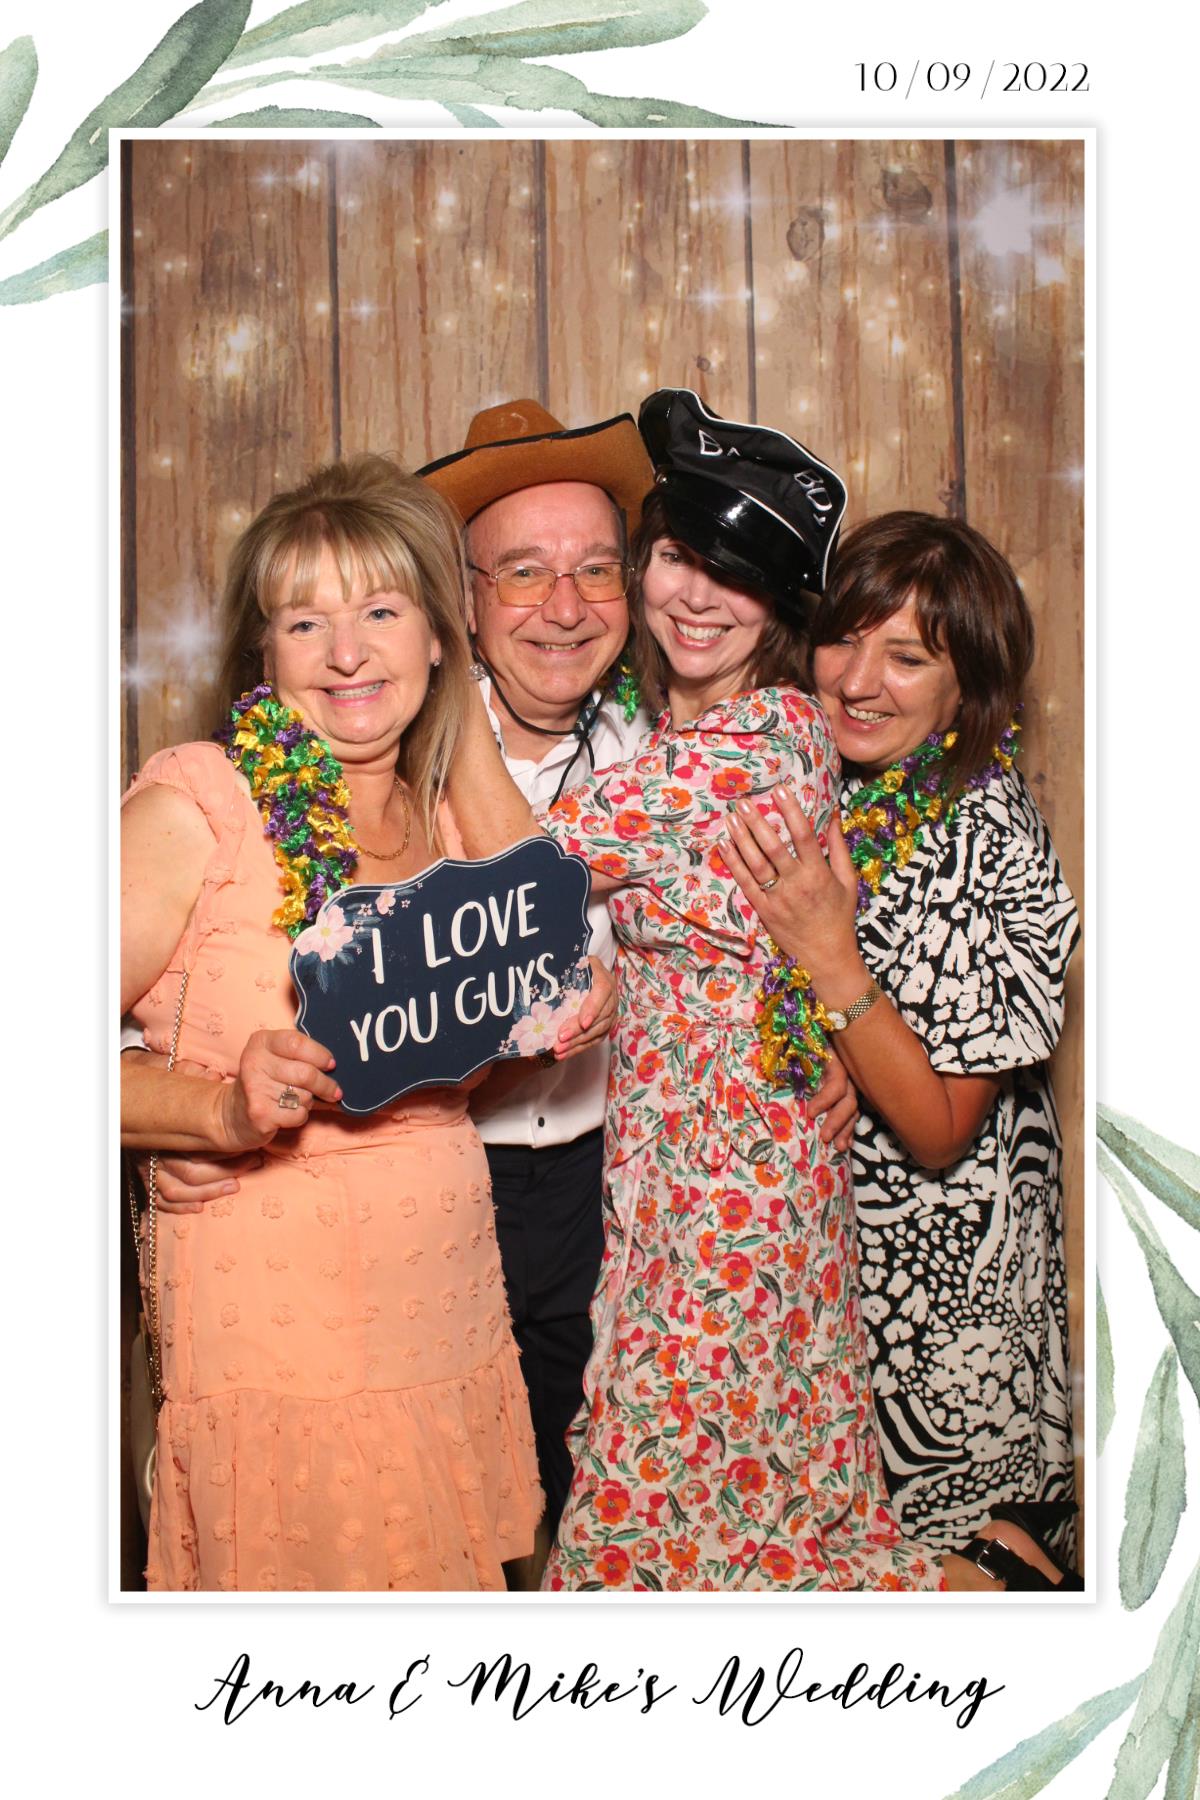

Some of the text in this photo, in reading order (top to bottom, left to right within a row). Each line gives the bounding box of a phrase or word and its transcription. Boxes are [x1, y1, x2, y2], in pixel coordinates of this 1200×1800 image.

[371, 881, 540, 985] I LOVE
[349, 952, 559, 1062] YOU GUYS
